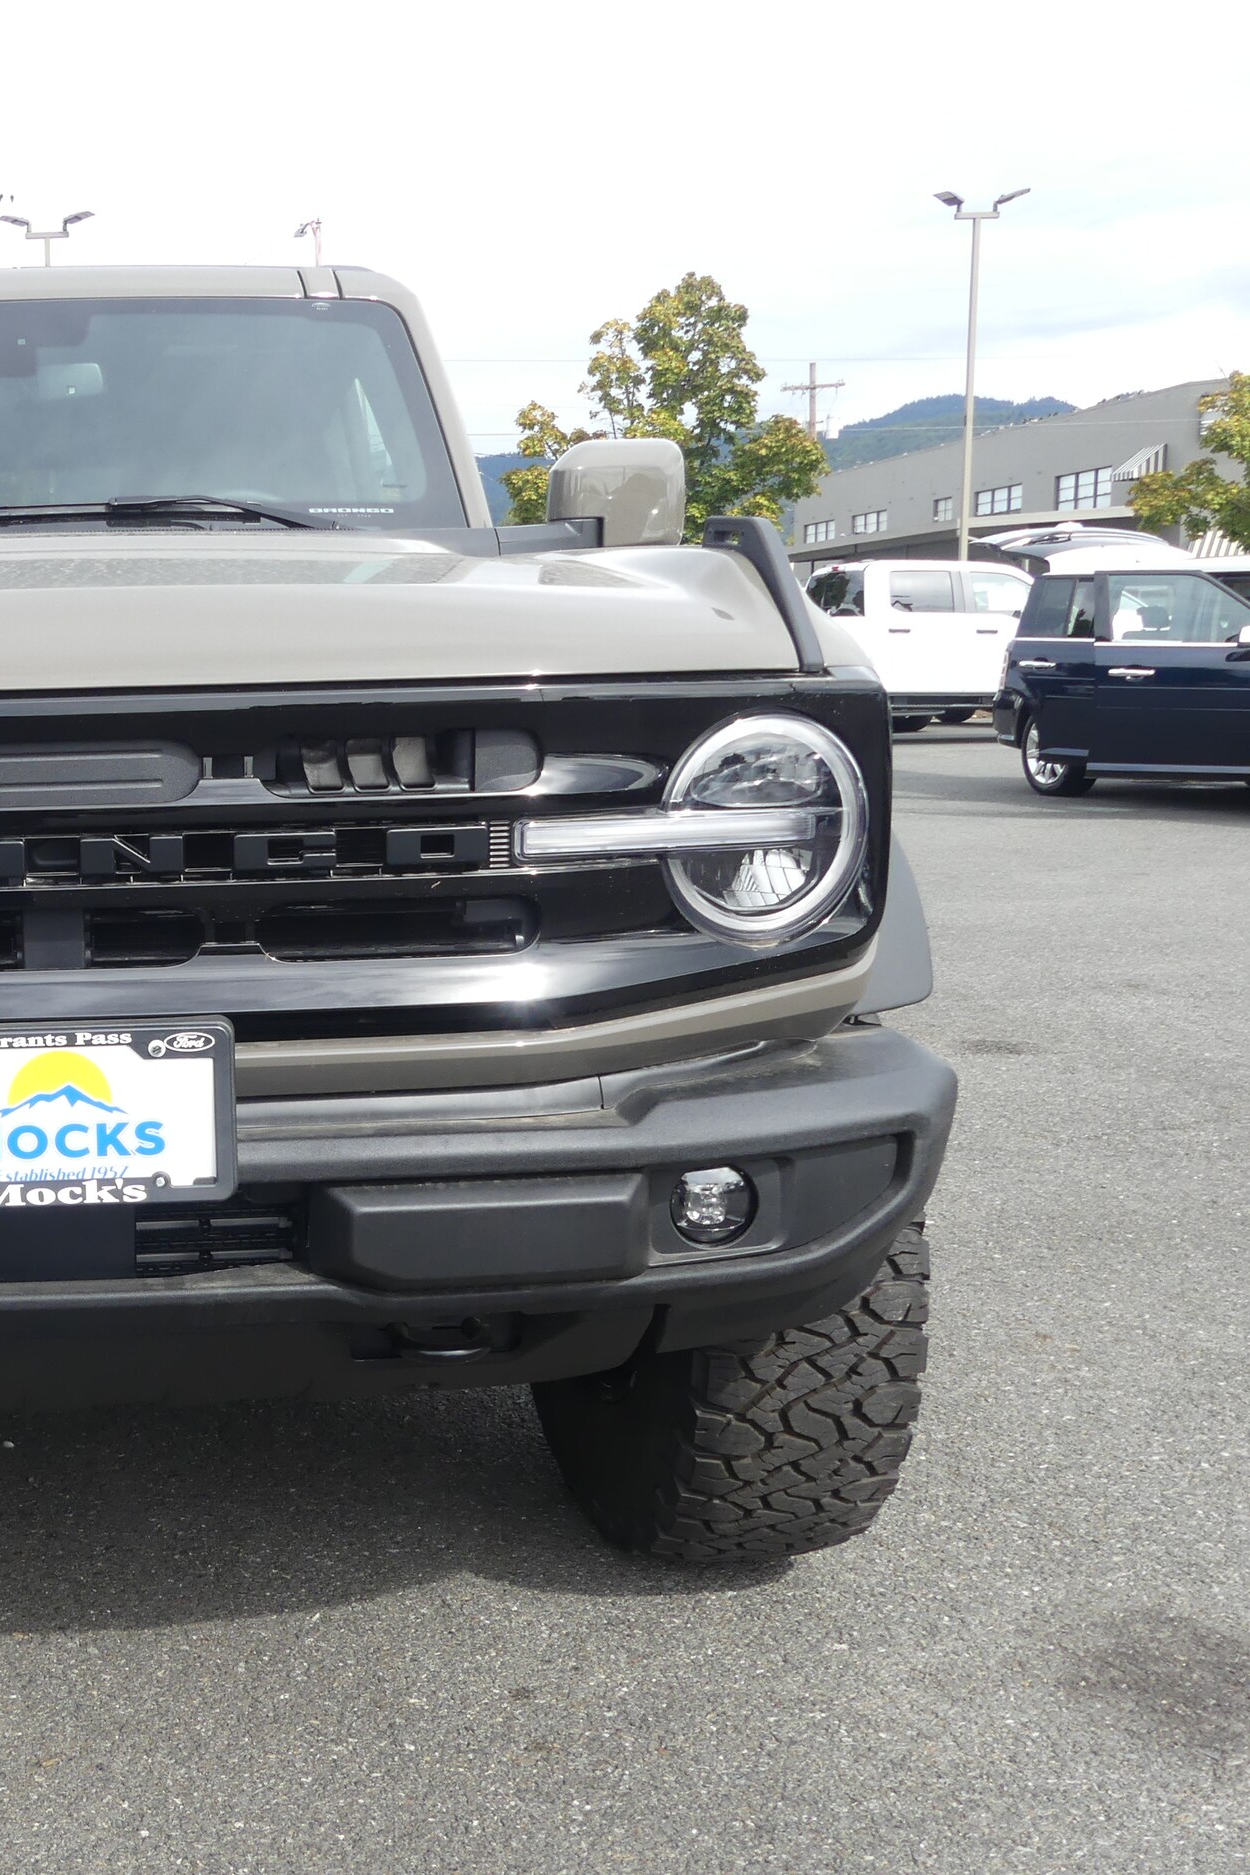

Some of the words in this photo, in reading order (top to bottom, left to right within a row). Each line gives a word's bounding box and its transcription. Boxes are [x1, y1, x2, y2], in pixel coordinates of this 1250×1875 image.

[75, 1032, 132, 1046] Pass
[172, 1034, 206, 1049] Ford
[90, 1165, 129, 1180] 1957
